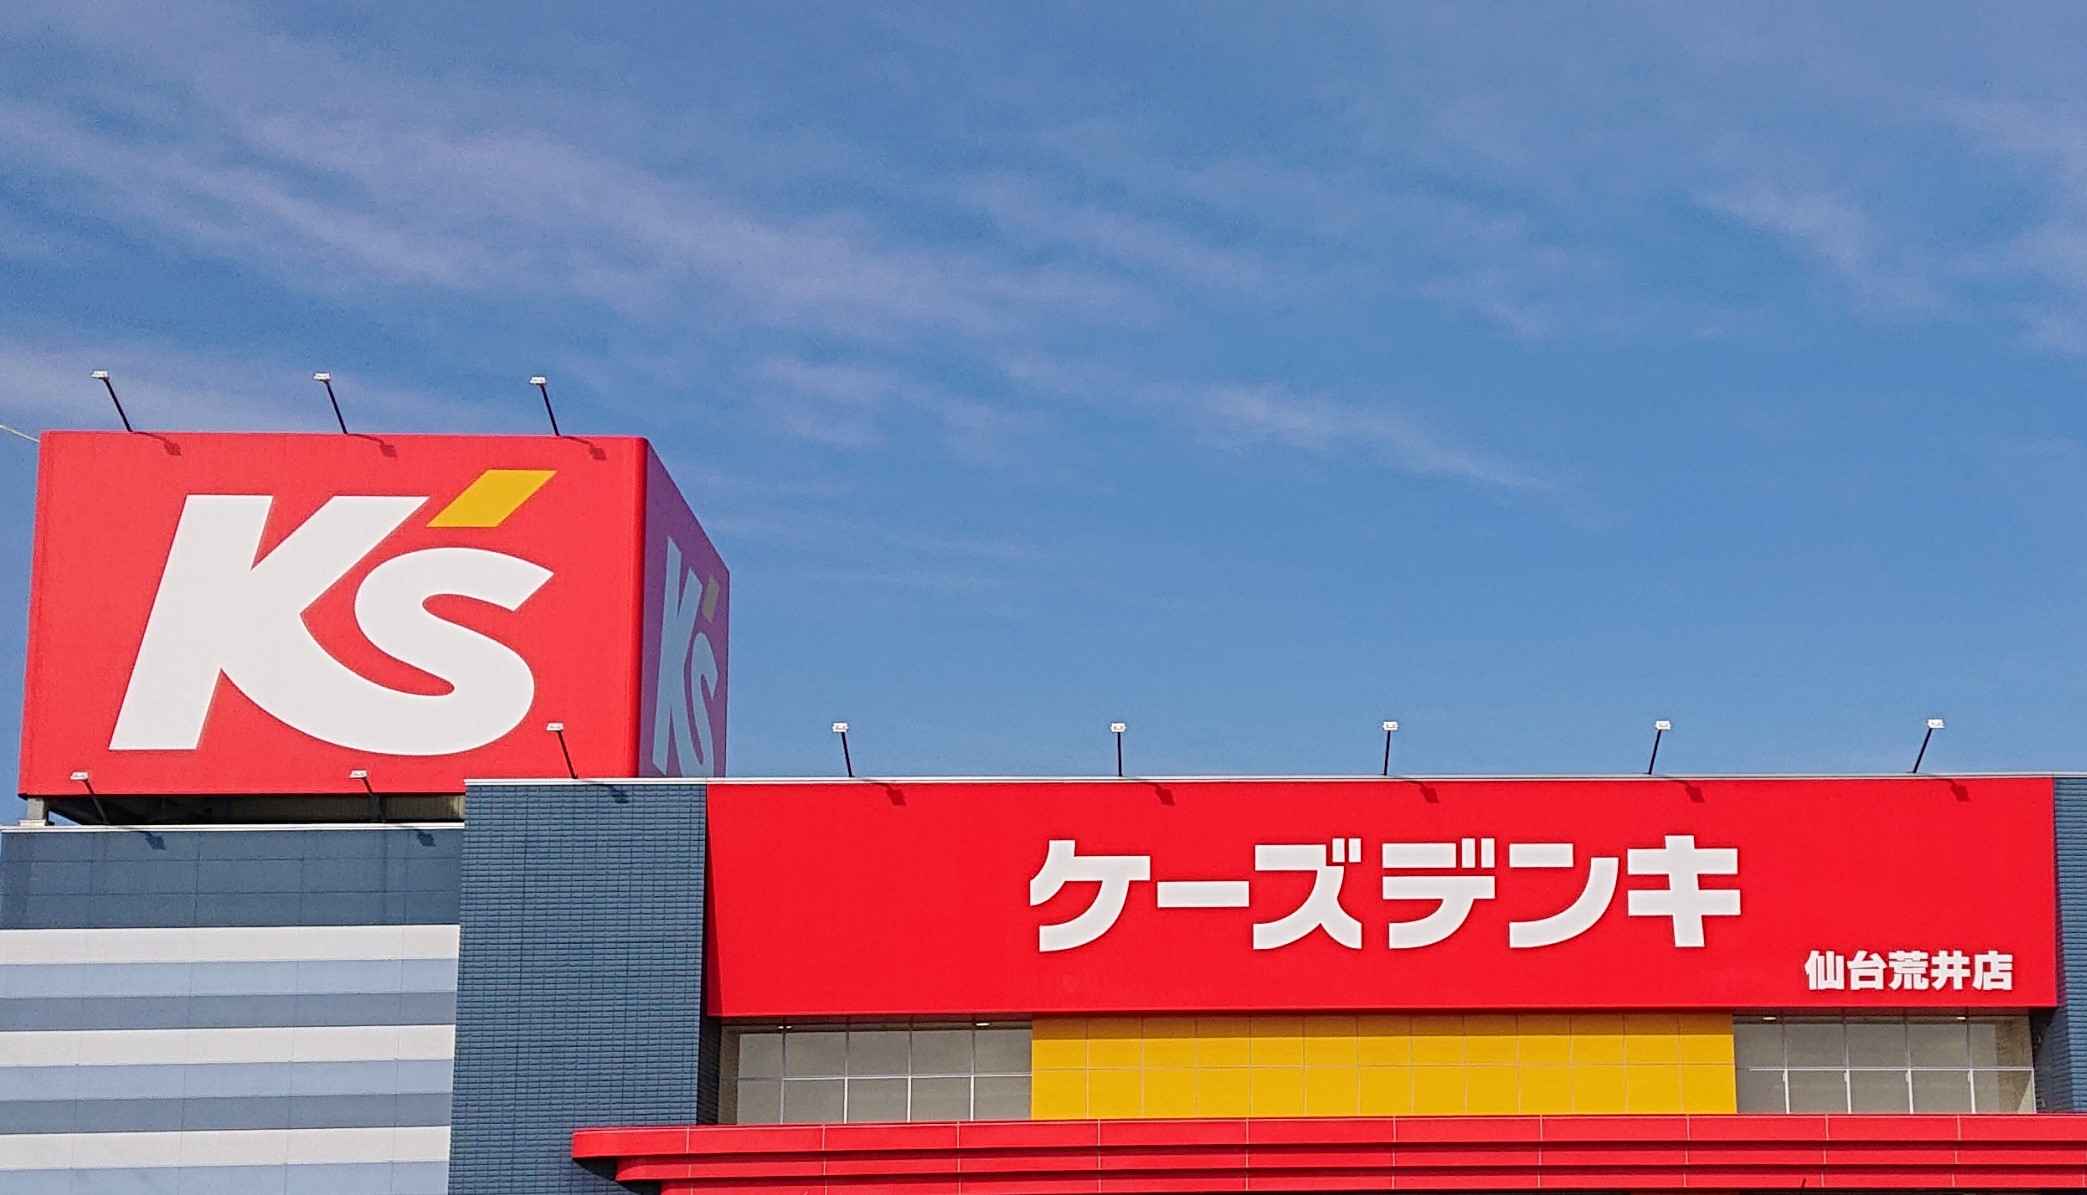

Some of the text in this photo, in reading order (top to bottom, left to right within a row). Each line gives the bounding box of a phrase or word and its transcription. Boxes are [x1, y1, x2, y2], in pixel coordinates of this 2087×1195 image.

[109, 469, 558, 756] K's
[1029, 834, 1742, 952] ケーズデンキ
[1804, 949, 2014, 991] 仙台荒井店
